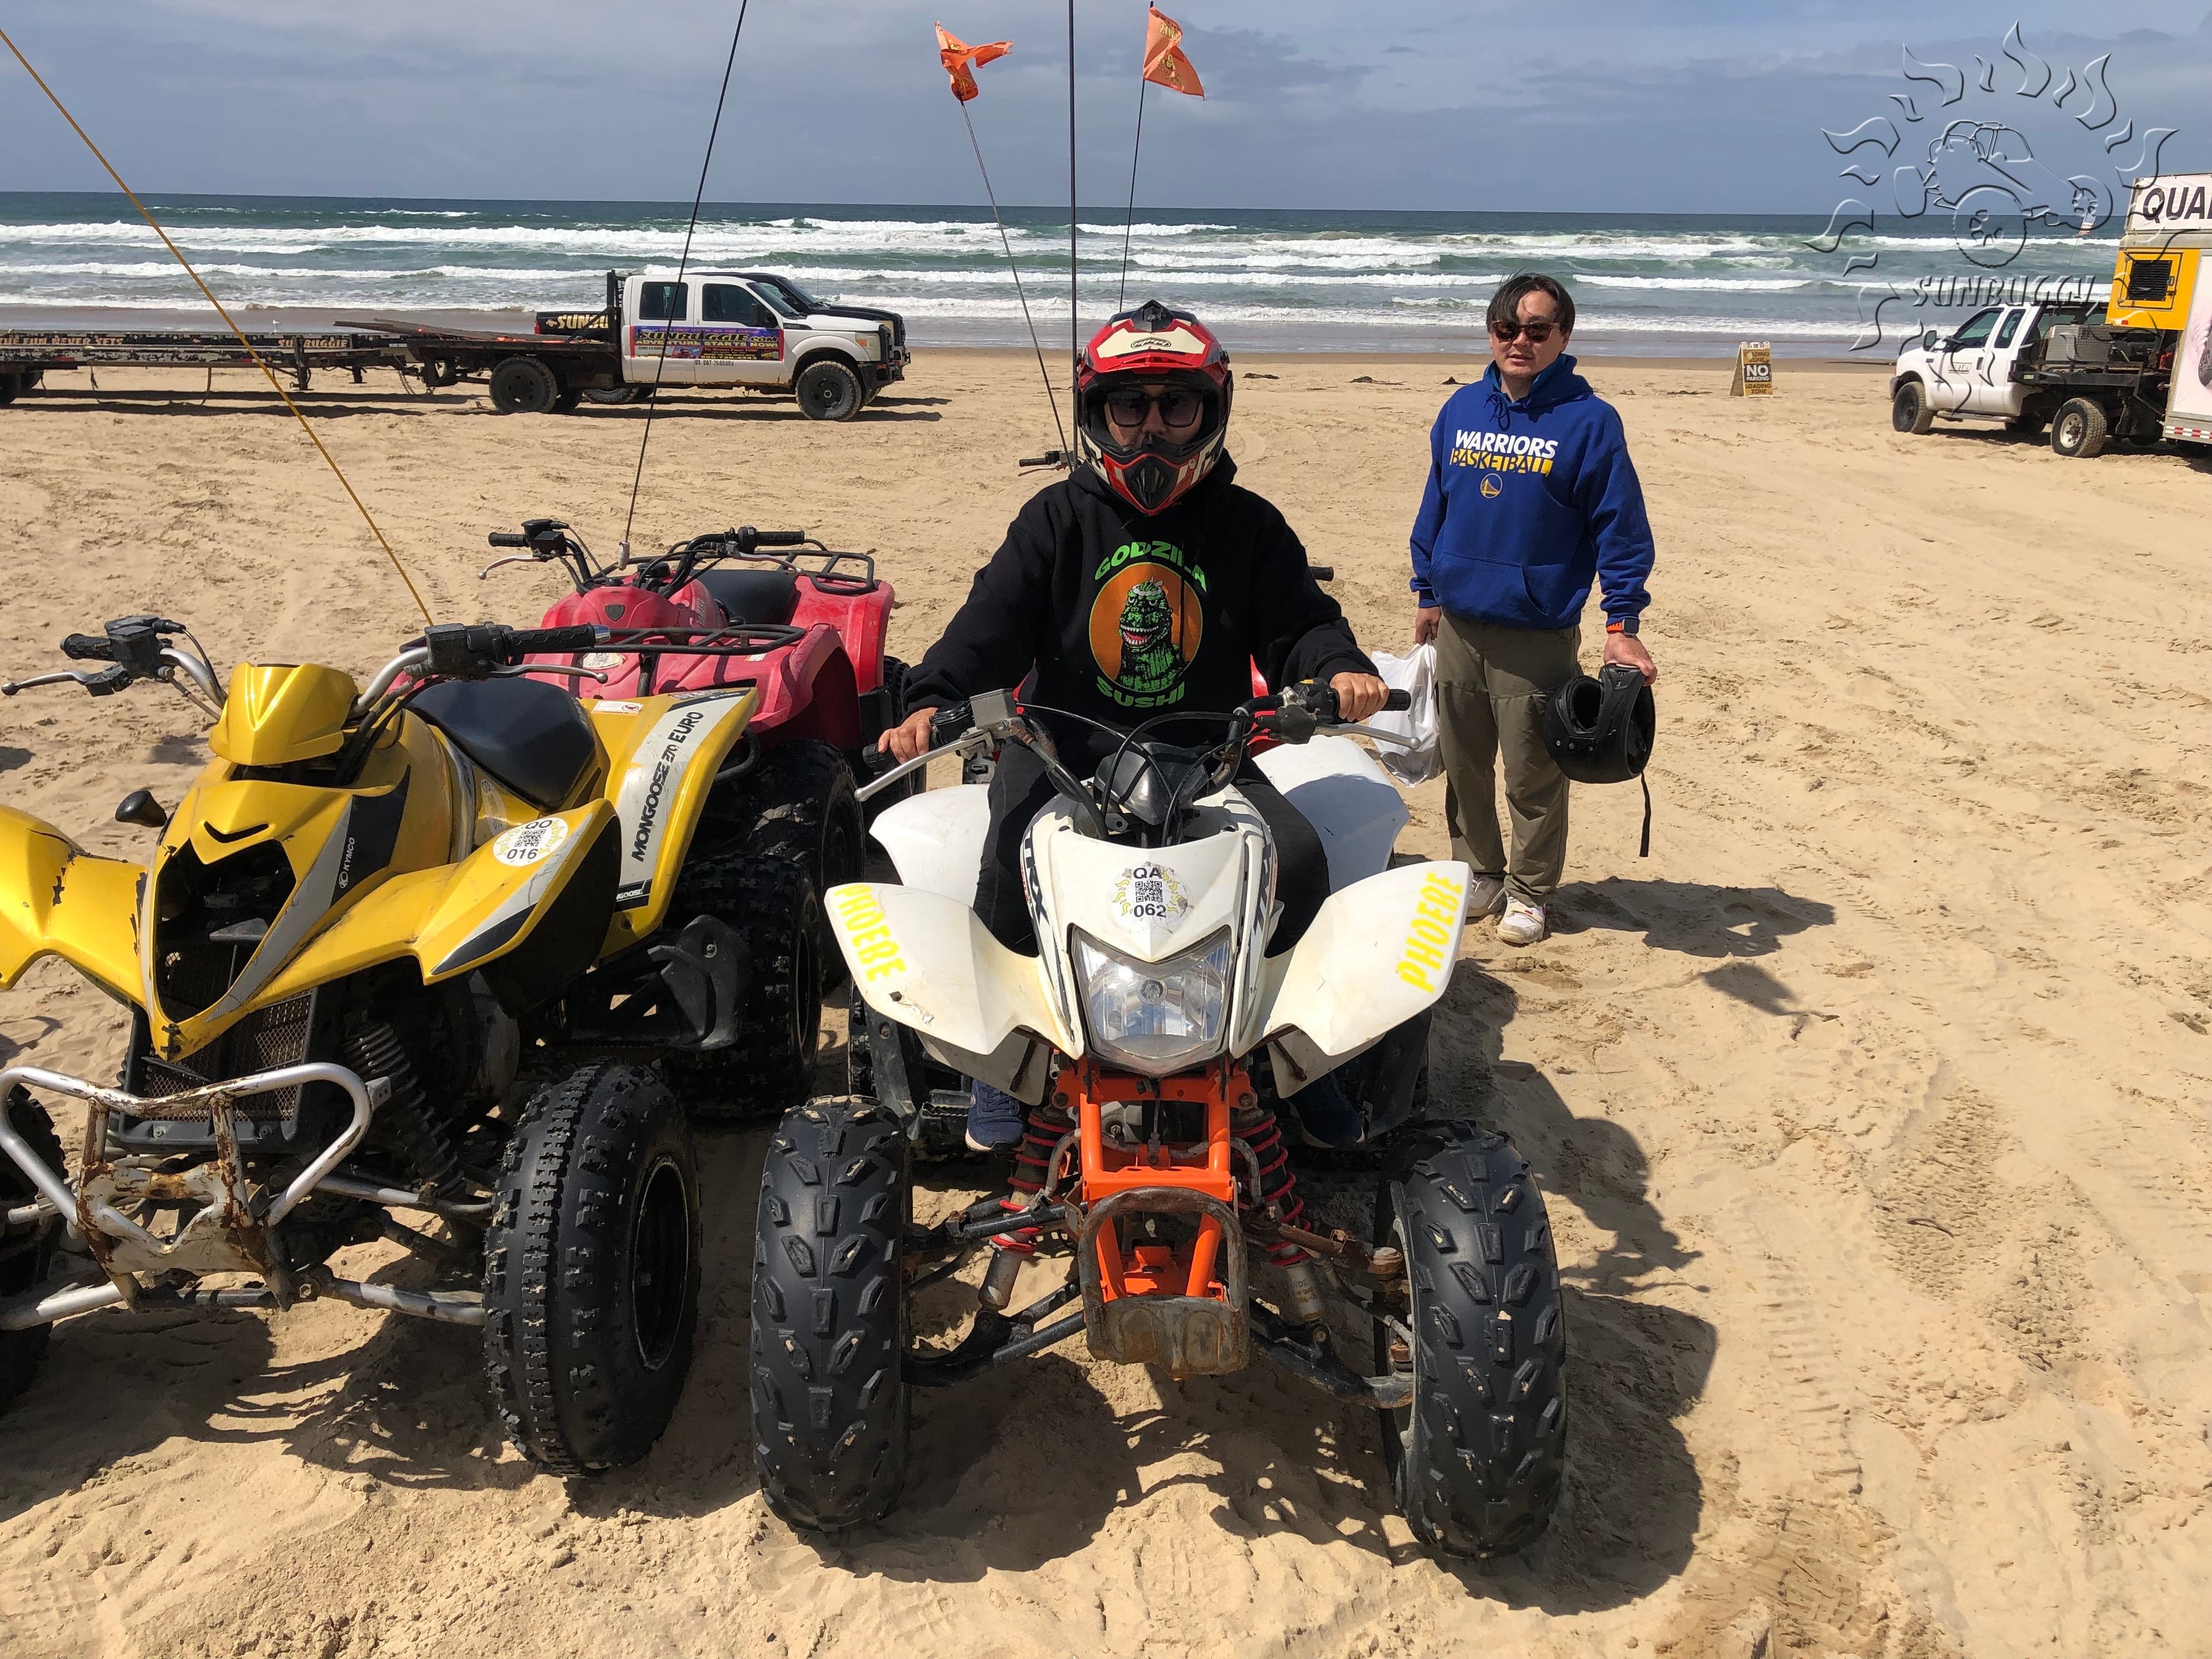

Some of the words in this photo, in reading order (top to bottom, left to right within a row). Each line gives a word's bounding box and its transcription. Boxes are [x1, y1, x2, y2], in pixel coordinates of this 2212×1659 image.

[2143, 187, 2212, 224] QUA
[278, 339, 348, 348] SUBUGGIE
[1746, 364, 1769, 377] NO
[1456, 429, 1558, 459] WARRIORS
[1449, 448, 1554, 477] BASKETBALL
[1097, 676, 1185, 708] SUSHI
[631, 761, 671, 862] MONGOOSE
[668, 711, 704, 744] EURO
[525, 820, 553, 830] QO
[343, 837, 355, 871] KYMCO
[506, 848, 539, 859] 016
[1133, 867, 1162, 879] QA
[1134, 903, 1166, 918] 062
[1396, 871, 1463, 995] PHOEBE
